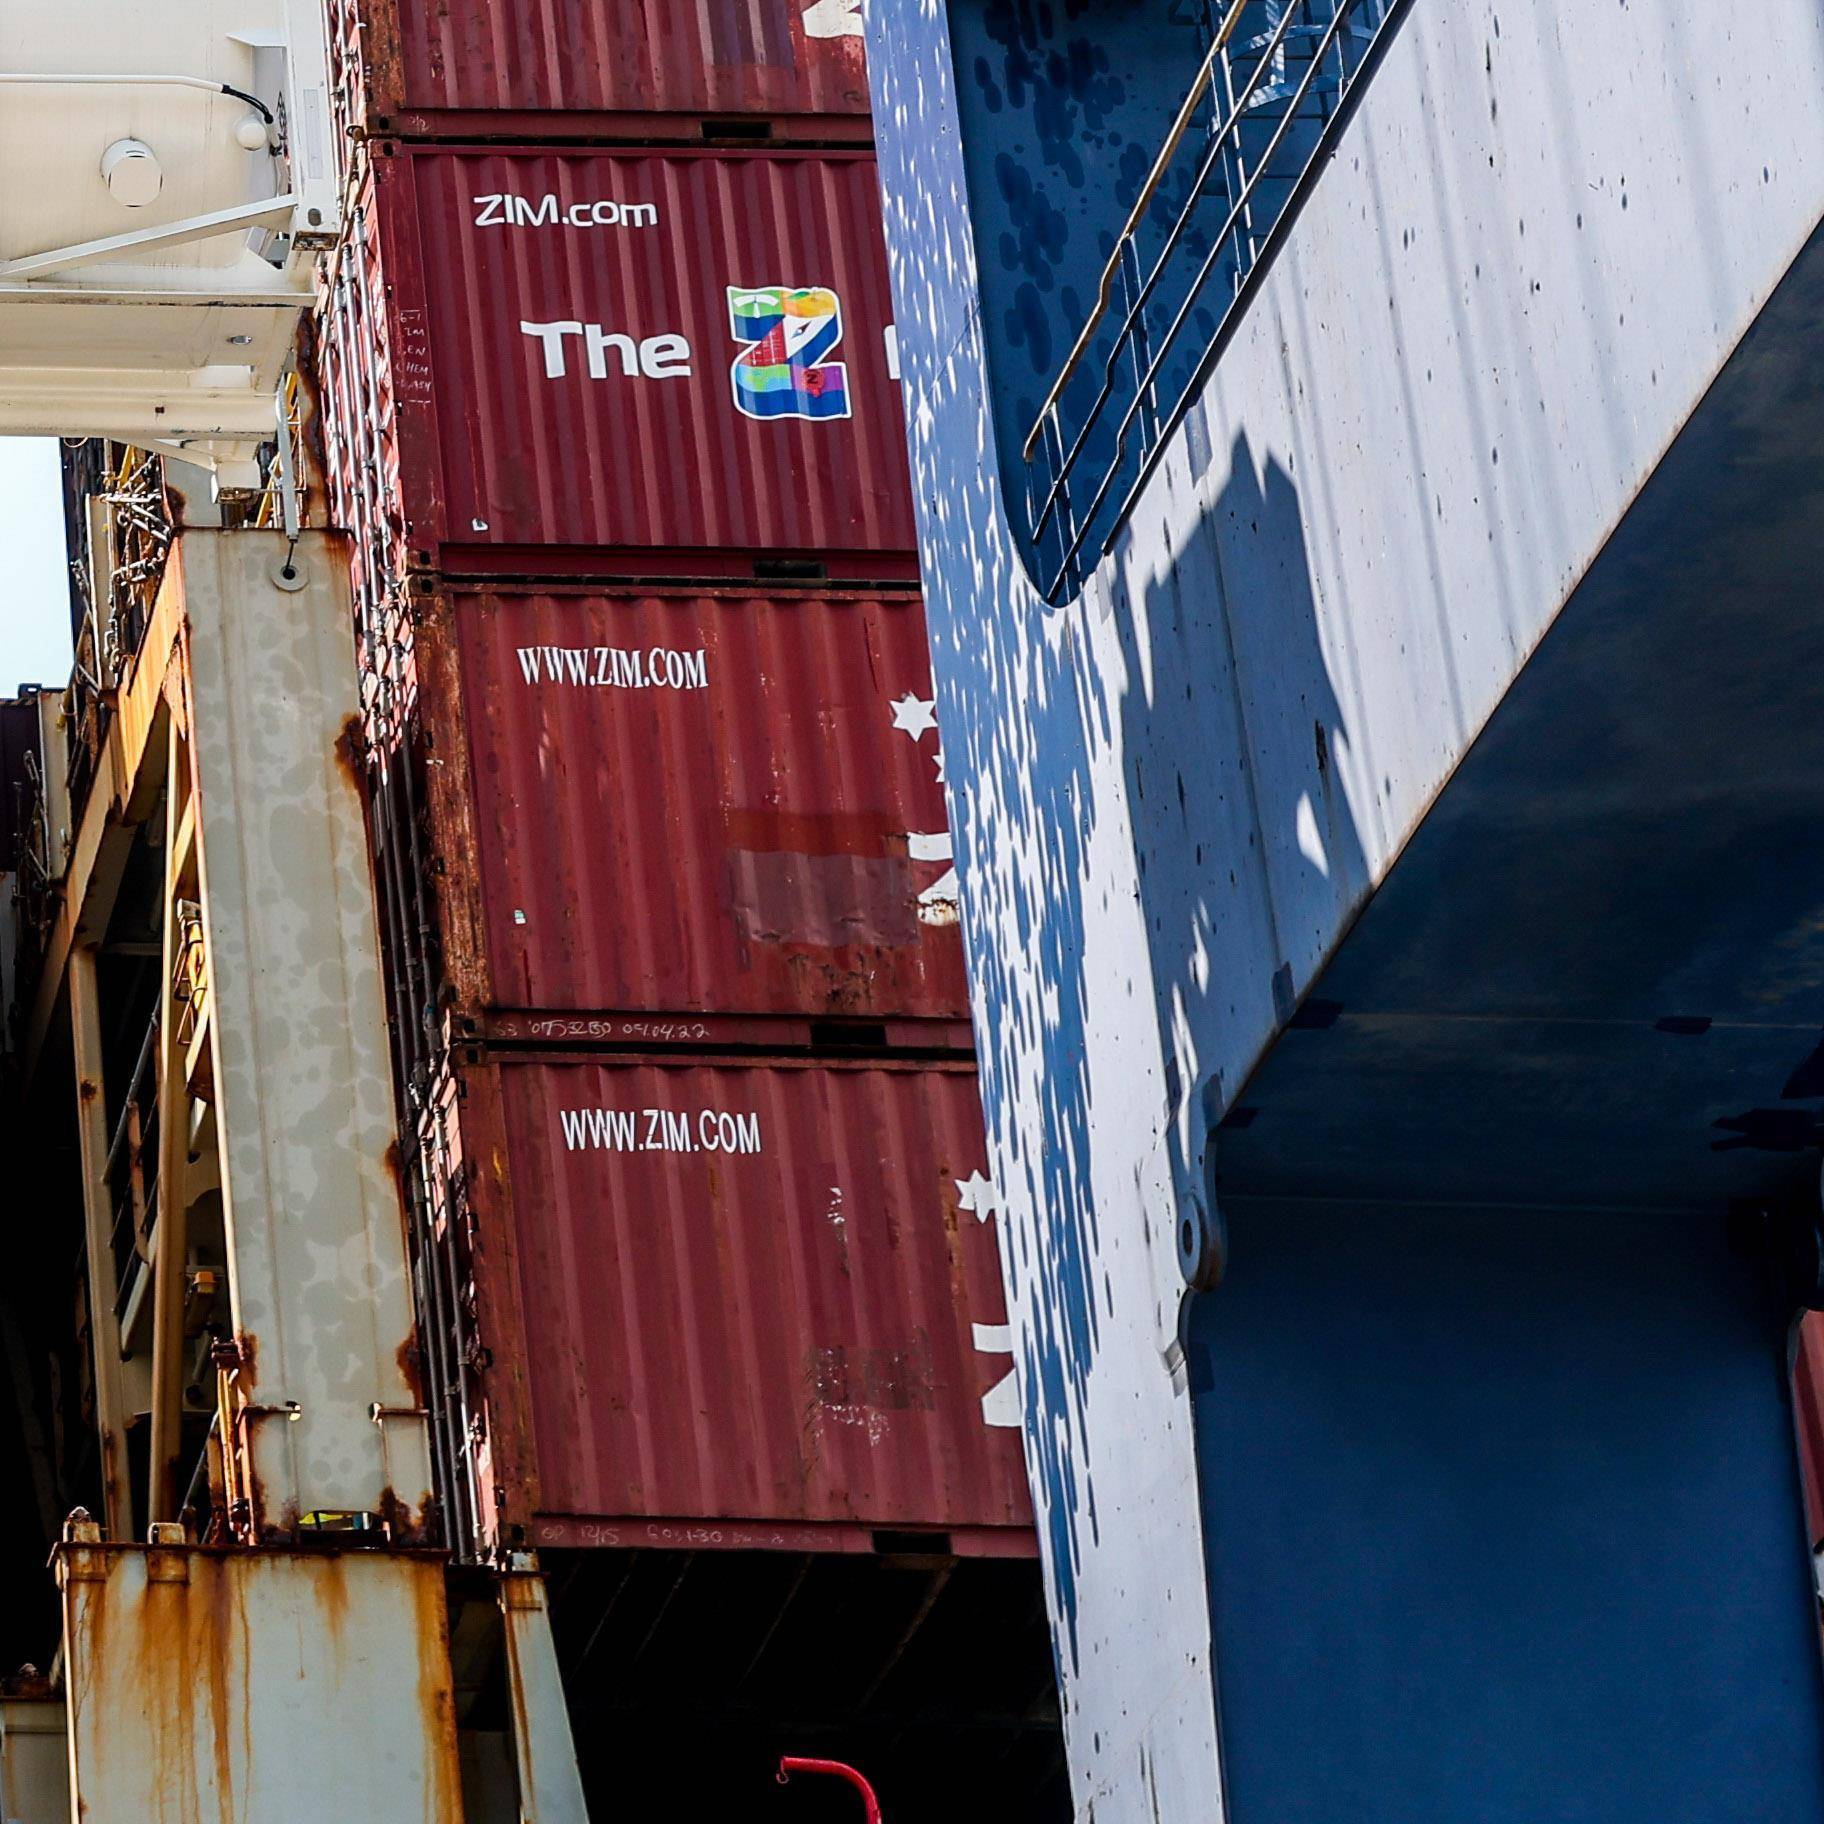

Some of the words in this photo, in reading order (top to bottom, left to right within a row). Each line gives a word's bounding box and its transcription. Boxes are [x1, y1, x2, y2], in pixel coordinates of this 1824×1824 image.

[474, 193, 657, 228] ZIM.com
[520, 321, 691, 379] The
[517, 647, 708, 690] WWW.ZIM.COM
[561, 1109, 762, 1155] WWW.ZIM.COM
